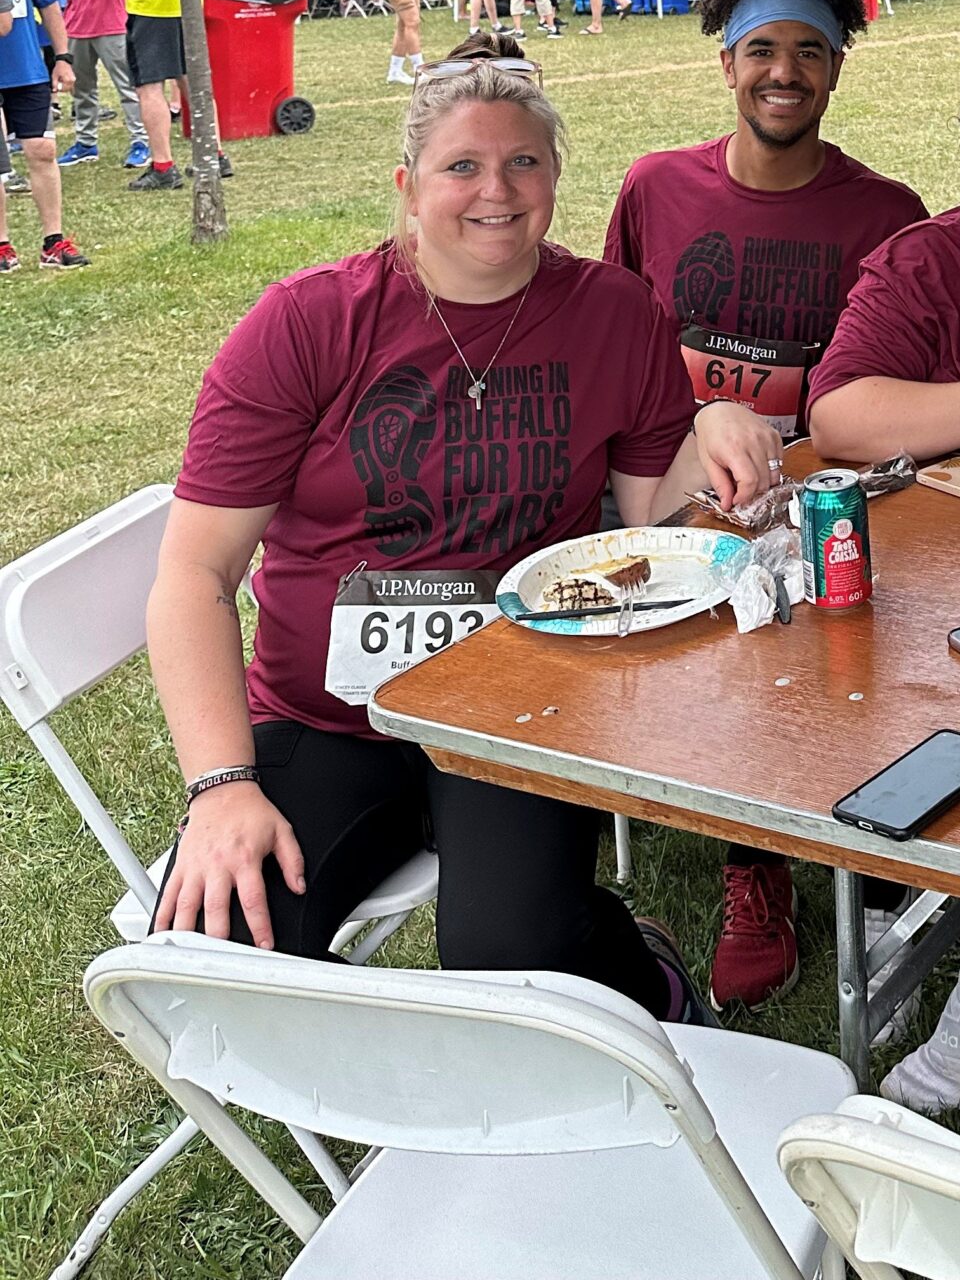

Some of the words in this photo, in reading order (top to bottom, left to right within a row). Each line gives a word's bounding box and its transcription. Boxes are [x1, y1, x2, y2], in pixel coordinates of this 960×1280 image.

[745, 237, 820, 268] RUNNING
[825, 243, 843, 270] IN
[739, 265, 841, 308] BUFFALO
[736, 302, 785, 340] FOR
[705, 335, 777, 360] J.P.Morgan
[447, 364, 544, 399] RUNNING
[548, 361, 570, 393] IN
[705, 359, 772, 399] 617
[443, 394, 572, 444] BUFFALO
[443, 443, 510, 497] FOR
[517, 440, 572, 493] 105
[440, 491, 565, 555] YEARS
[376, 579, 476, 601] J.P.Morgan
[848, 592, 860, 602] 60
[391, 661, 417, 670] Buff
[198, 771, 253, 791] BRENDON
